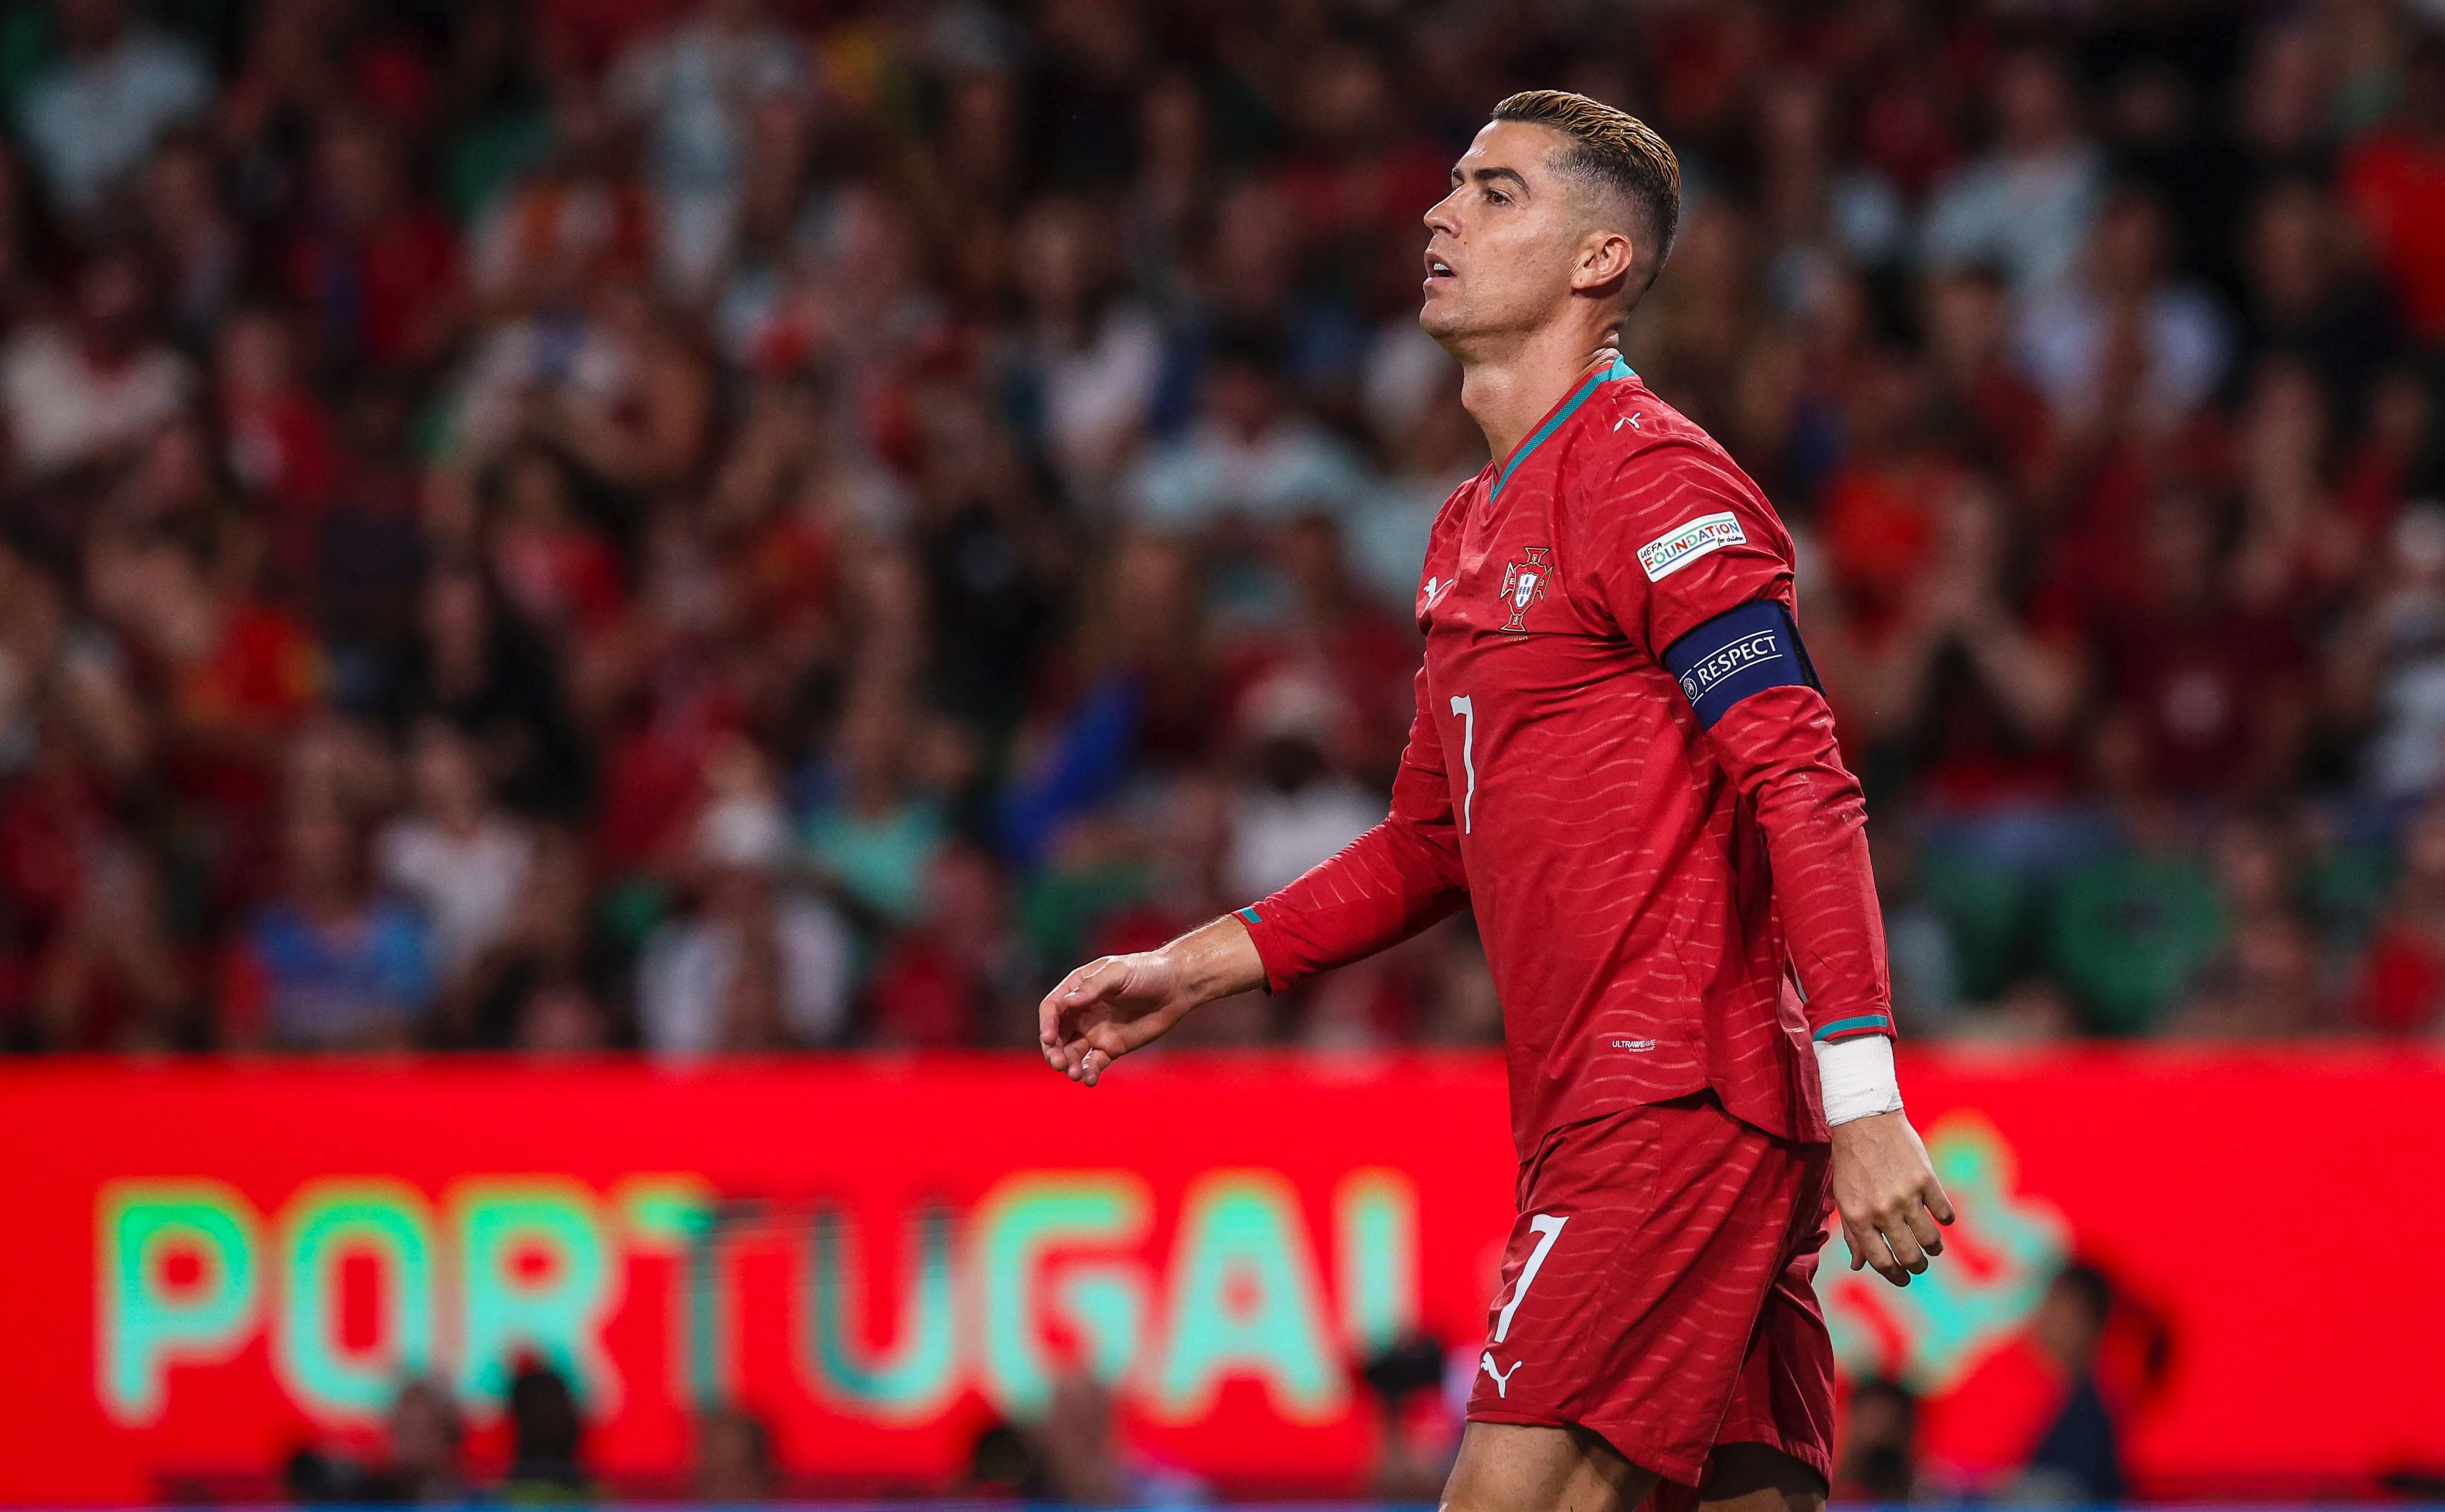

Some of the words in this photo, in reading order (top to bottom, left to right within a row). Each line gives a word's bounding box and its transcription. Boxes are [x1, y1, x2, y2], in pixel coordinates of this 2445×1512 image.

[1640, 542, 1663, 559] UEFA
[1697, 636, 1776, 686] RESPECT
[1450, 694, 1475, 835] 7
[1612, 1039, 1656, 1048] ULTRAWEAVE
[1494, 1214, 1570, 1344] 7
